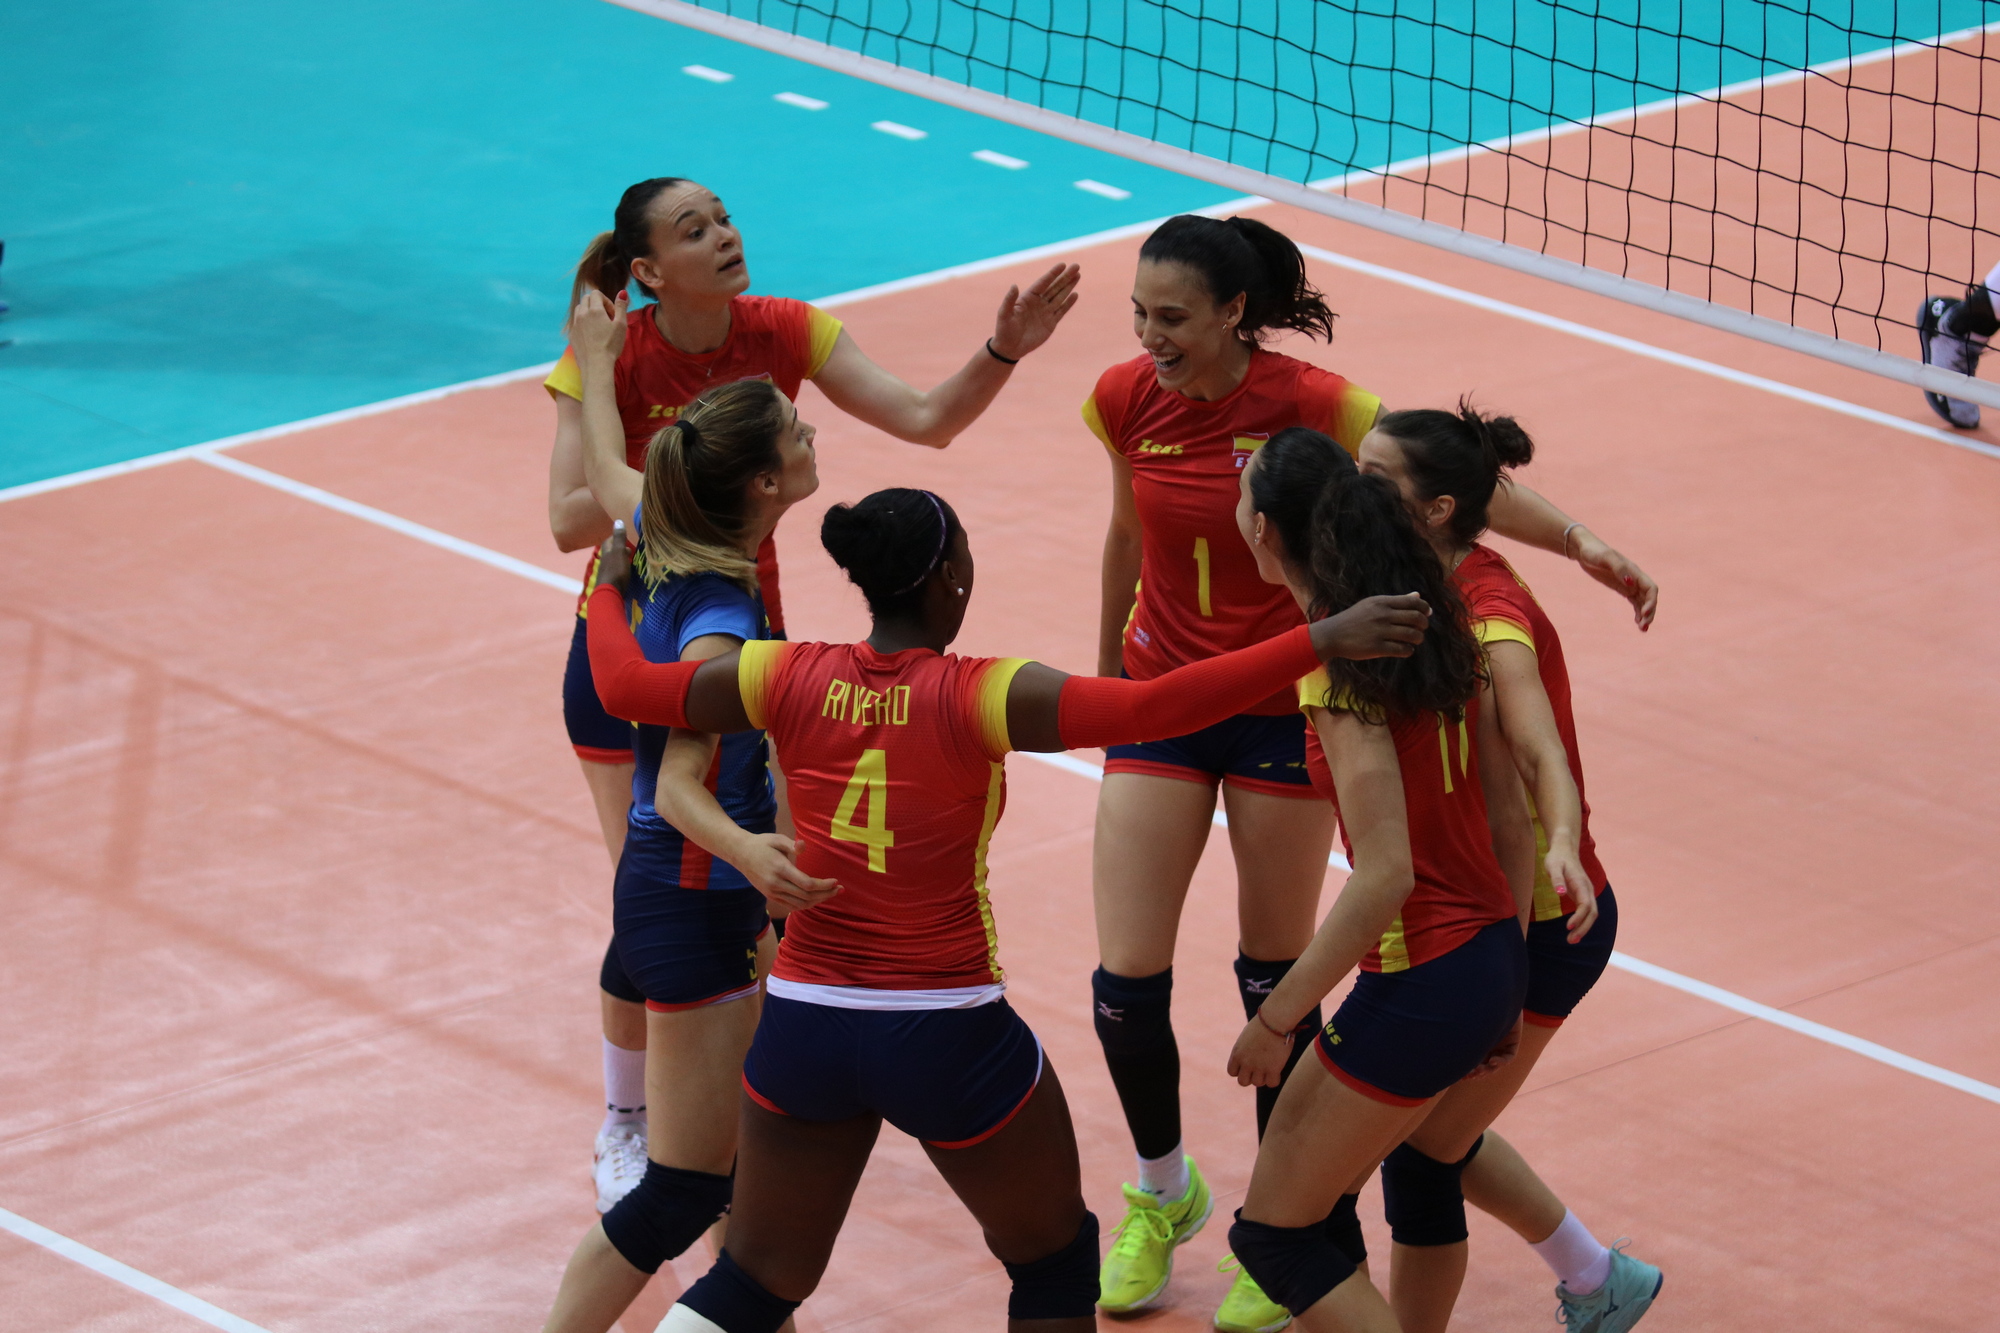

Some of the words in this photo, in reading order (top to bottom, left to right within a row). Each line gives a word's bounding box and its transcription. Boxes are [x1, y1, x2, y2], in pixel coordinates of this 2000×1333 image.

[1138, 439, 1184, 454] Zeus
[1193, 536, 1213, 617] 1
[822, 678, 911, 726] RIVERO
[830, 749, 894, 873] 4
